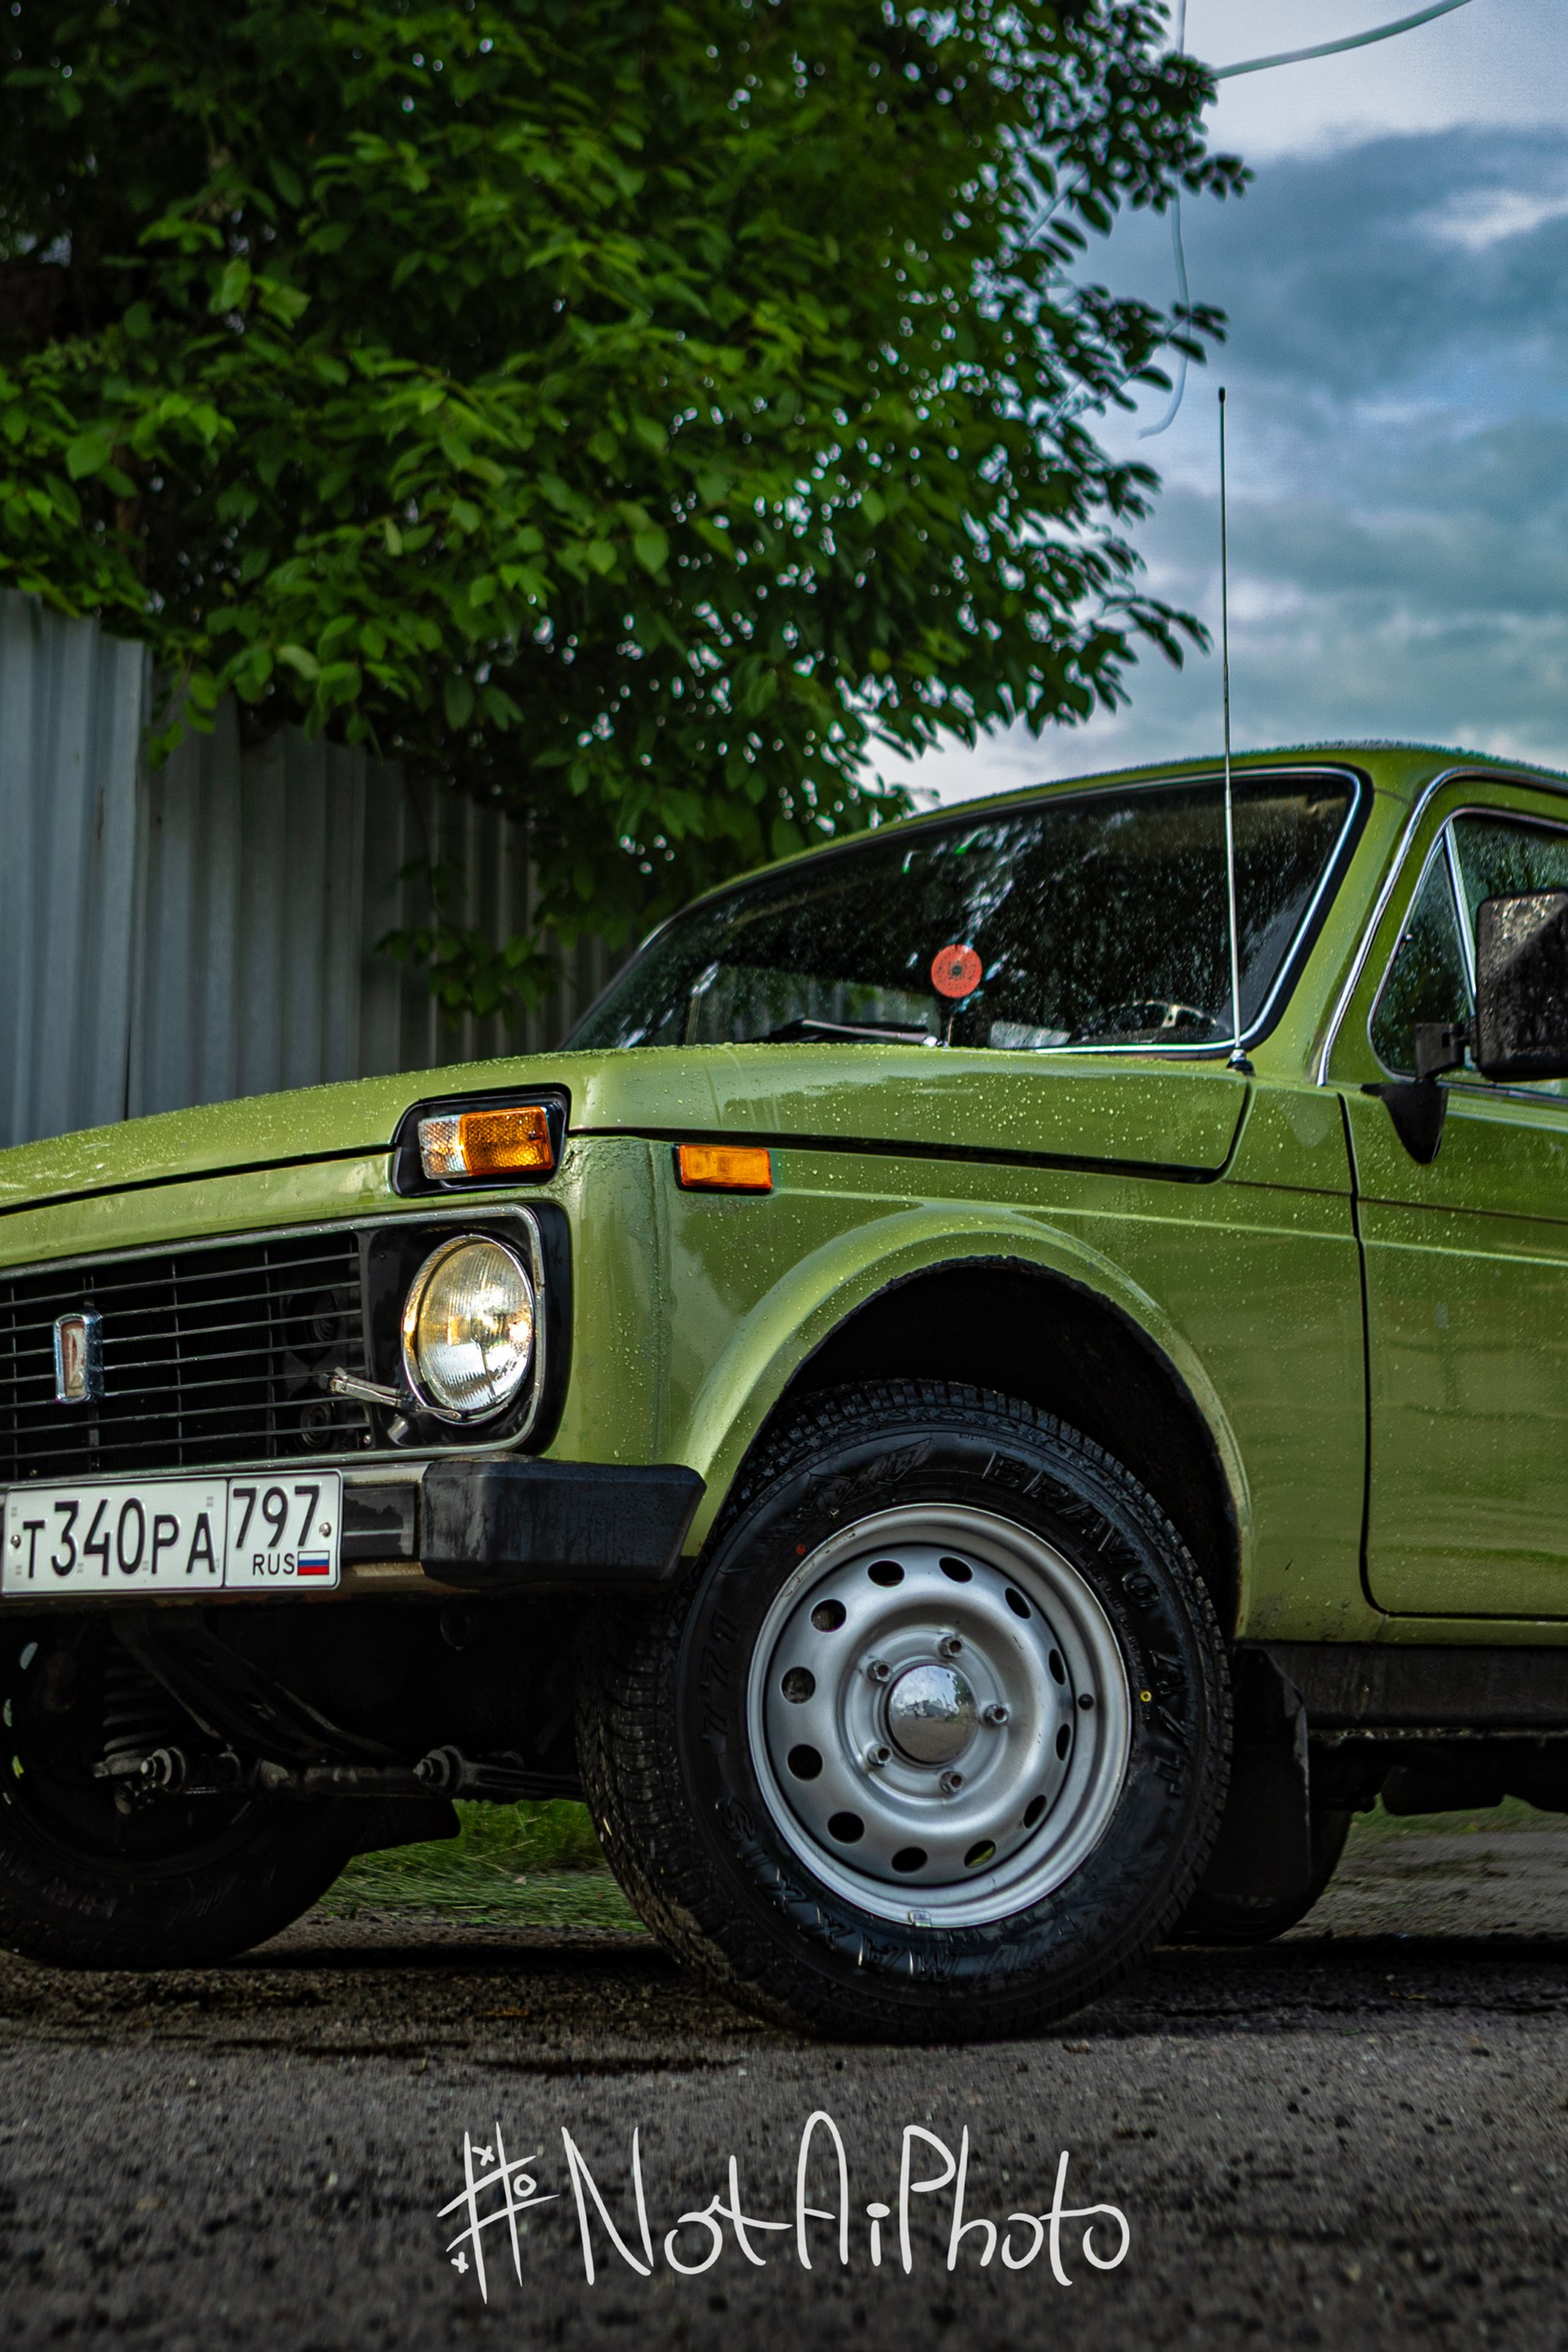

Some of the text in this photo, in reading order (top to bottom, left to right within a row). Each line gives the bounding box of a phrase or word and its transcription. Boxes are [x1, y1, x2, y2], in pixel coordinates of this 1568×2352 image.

[233, 1485, 321, 1549] 797
[252, 1553, 295, 1576] RUS
[981, 1451, 1160, 1611] BRAVO
[701, 1609, 960, 1985] MAXXIS 771
